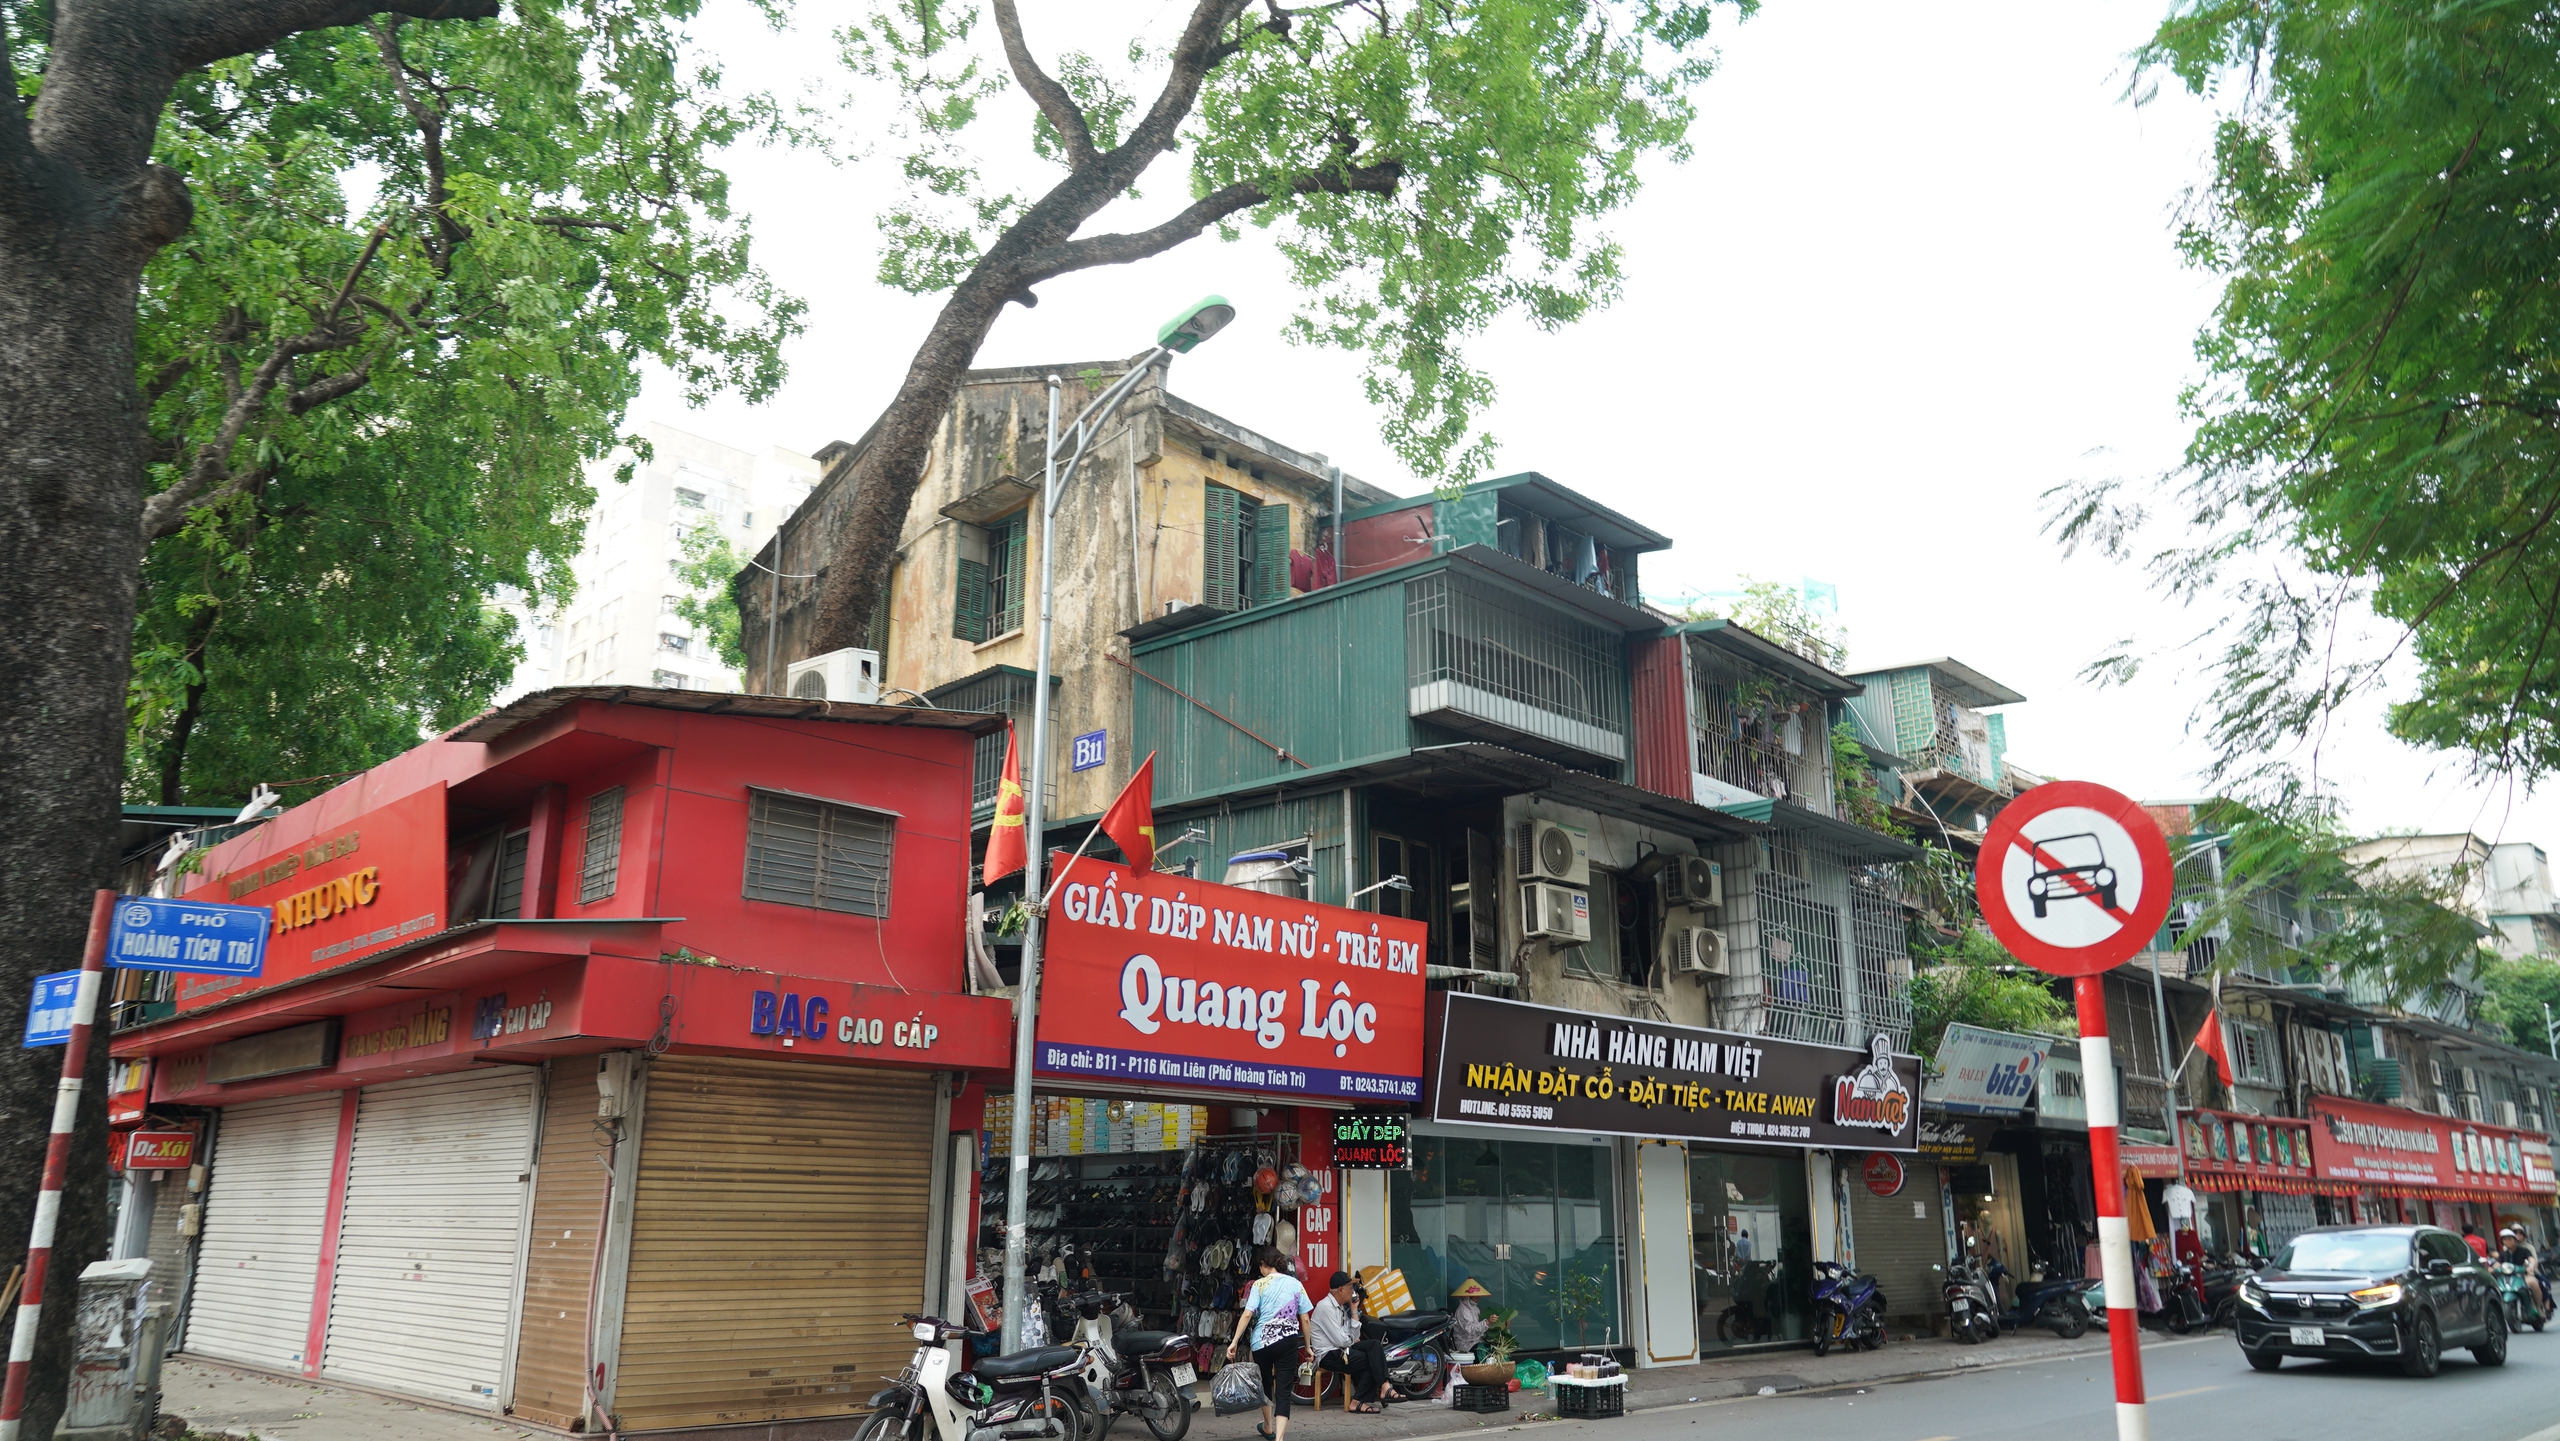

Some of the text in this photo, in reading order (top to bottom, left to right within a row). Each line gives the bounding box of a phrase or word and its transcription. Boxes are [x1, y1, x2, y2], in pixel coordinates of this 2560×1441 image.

[1075, 738, 1102, 767] B11
[276, 867, 380, 934] NHUNG
[180, 912, 229, 928] PHỐ
[1063, 870, 1143, 930] GIẦY
[1149, 891, 1206, 941] DÉP
[1212, 907, 1273, 953] NAM
[1280, 914, 1319, 959] NỮ
[1335, 923, 1381, 970] TRẺ
[1387, 939, 1419, 976] EM
[121, 930, 255, 965] HOÀNG TÍCH TRÍ
[53, 979, 76, 997] PHỐ
[1119, 953, 1377, 1058] Quang Lộc
[408, 1001, 450, 1048] VÀNG
[506, 1006, 527, 1035] CAO
[529, 988, 552, 1030] CẤP
[750, 990, 939, 1049] BẠC CAO CẤP
[1553, 1020, 1763, 1083] NHÀ HÀNG NAM VIỆT
[1047, 1048, 1067, 1070] Địa
[1070, 1050, 1093, 1069] chỉ:
[1096, 1053, 1117, 1071] B11
[1129, 1056, 1157, 1075] P116
[1159, 1059, 1181, 1077] Kim
[1183, 1061, 1206, 1079] Liên
[1208, 1063, 1233, 1082] (Phố
[1234, 1066, 1265, 1086] Hoàng
[1268, 1069, 1288, 1087] Tích
[1290, 1071, 1306, 1089] Trí)
[1340, 1075, 1354, 1091] ĐT:
[1355, 1077, 1417, 1096] 0243.5741.452
[1467, 1062, 1532, 1097] NHẬN
[1538, 1067, 1580, 1102] ĐẶT
[1585, 1067, 1615, 1100] CỖ
[1629, 1076, 1668, 1110] ĐẶT
[1672, 1081, 1712, 1113] TIỆC
[1725, 1089, 1768, 1114] TAKE
[1770, 1095, 1816, 1117] AWAY
[1460, 1099, 1554, 1121] HOTLINE: 08 5555 5050
[1373, 1119, 1402, 1141] DÉP
[1790, 1126, 1799, 1138] 22
[1337, 1143, 1404, 1167] QUANG LỘC
[1306, 1204, 1332, 1236] CẶP
[1307, 1238, 1328, 1268] TÚI
